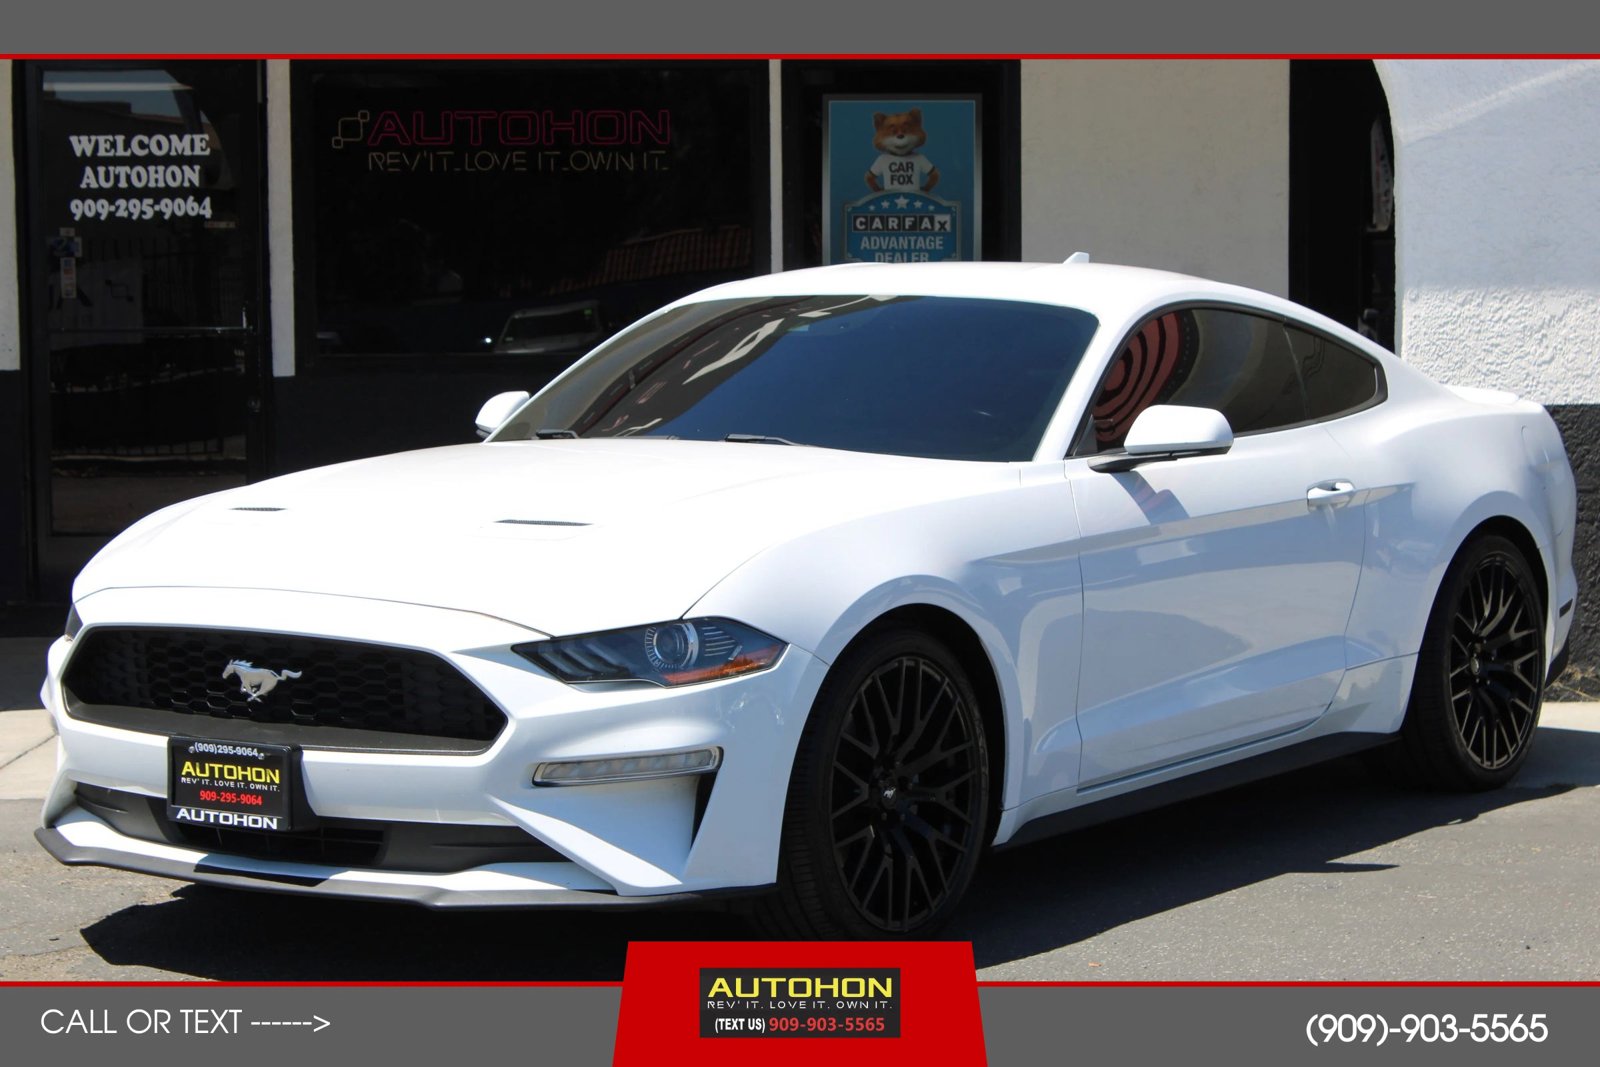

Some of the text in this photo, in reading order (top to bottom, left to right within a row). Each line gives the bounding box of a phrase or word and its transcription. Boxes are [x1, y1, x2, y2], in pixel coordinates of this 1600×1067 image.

[367, 110, 671, 146] AUTOHON
[69, 133, 211, 157] WELCOME
[465, 151, 527, 172] LOVE
[889, 161, 914, 173] CAR
[79, 165, 201, 189] AUTOHON
[890, 174, 914, 185] FOX
[69, 195, 213, 221] 909-295-9064
[853, 215, 950, 232] CARFAX
[860, 235, 944, 250] ADVANTAGE
[194, 742, 259, 758] (909)295-9064
[181, 761, 280, 784] AUTOHON
[214, 780, 235, 788] LOVE
[249, 783, 268, 791] OWN
[200, 790, 262, 805] 909-295-9064
[176, 808, 278, 830] AUTOHON
